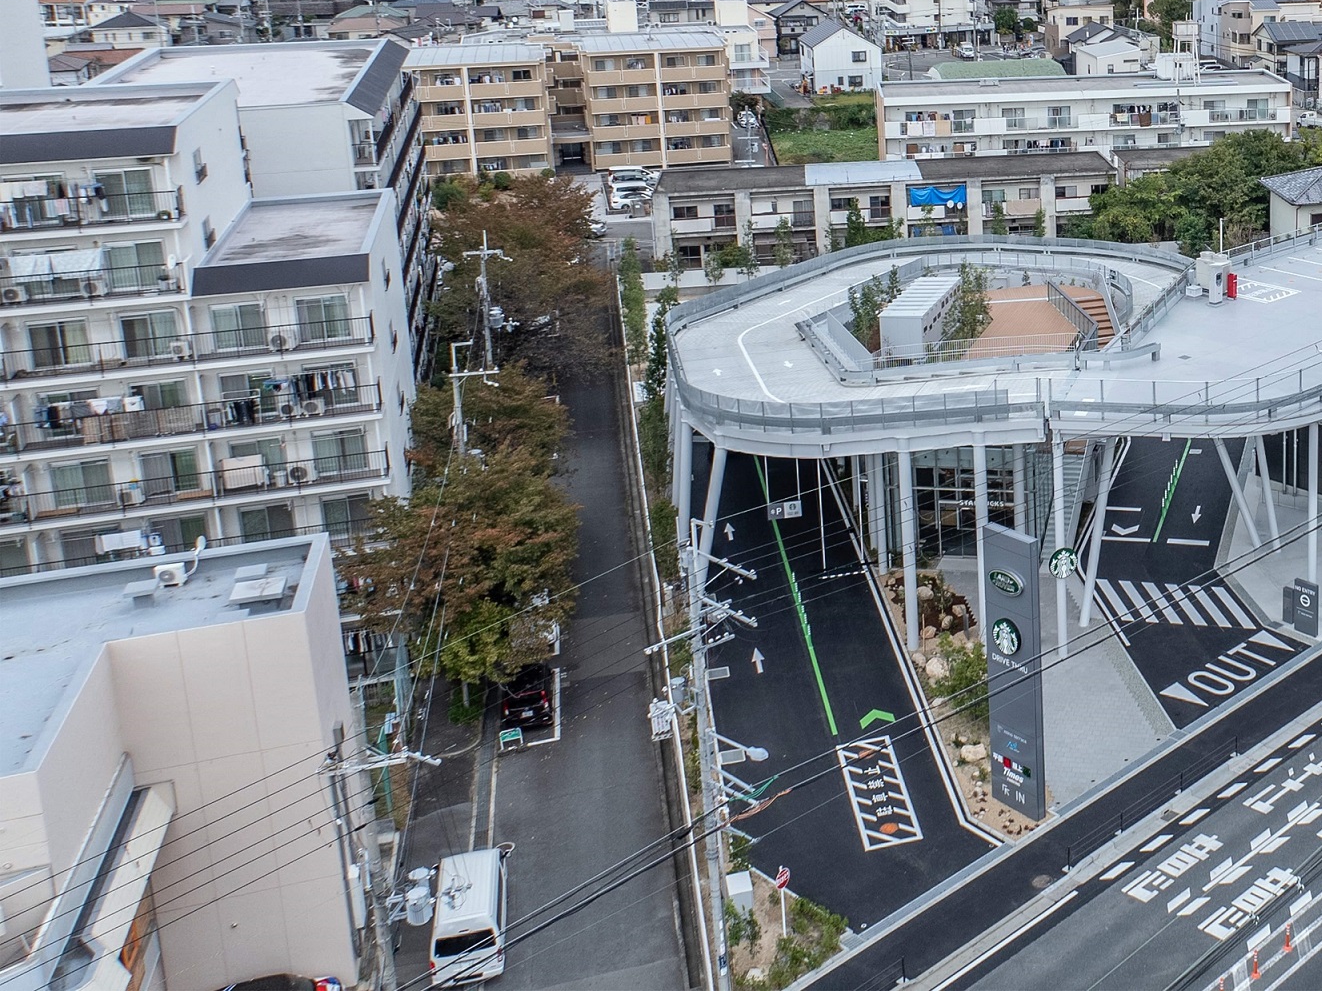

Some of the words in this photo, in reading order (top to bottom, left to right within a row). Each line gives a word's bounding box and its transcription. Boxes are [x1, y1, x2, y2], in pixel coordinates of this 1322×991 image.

[1302, 587, 1316, 596] ENTRY
[991, 652, 1010, 667] DRIVE
[1187, 642, 1277, 696] OUT
[1015, 790, 1025, 805] IN
